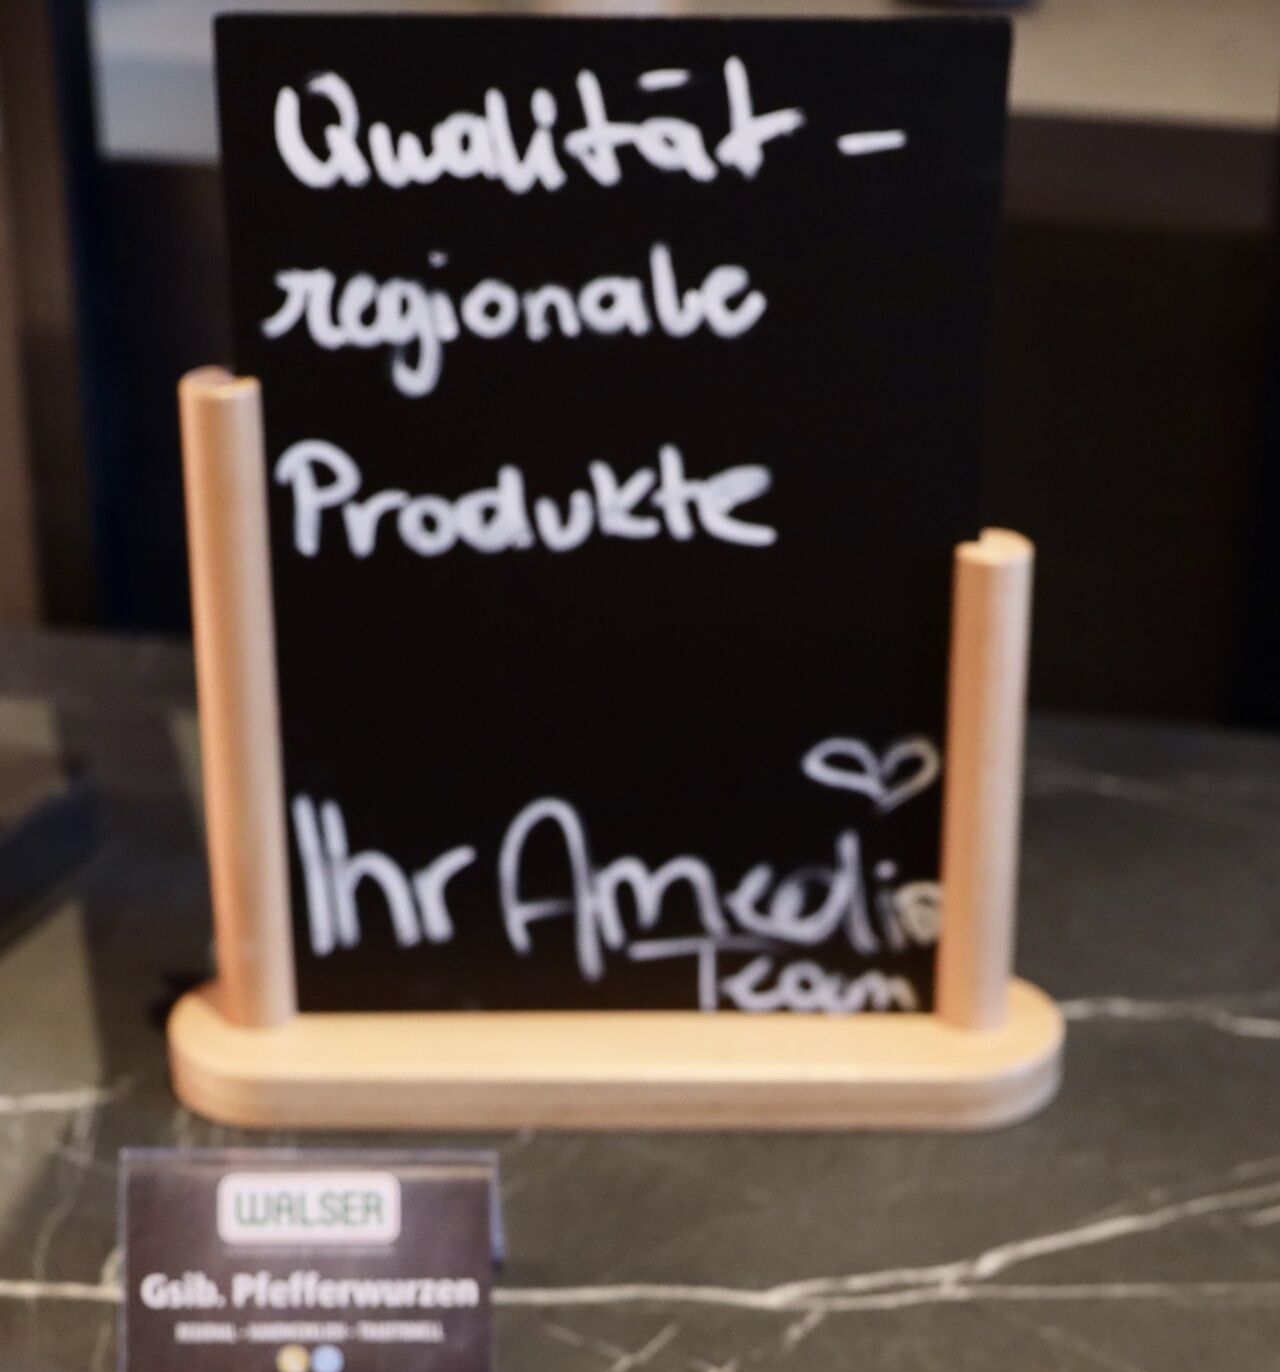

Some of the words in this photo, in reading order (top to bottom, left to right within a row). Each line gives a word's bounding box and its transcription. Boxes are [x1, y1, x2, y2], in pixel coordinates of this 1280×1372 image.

[275, 57, 804, 193] Qualität
[262, 243, 767, 397] regionale
[275, 439, 777, 557] Produkte
[294, 794, 475, 955] Ihr
[234, 1190, 386, 1227] WALSER
[231, 1270, 480, 1309] Pfefferwurzen
